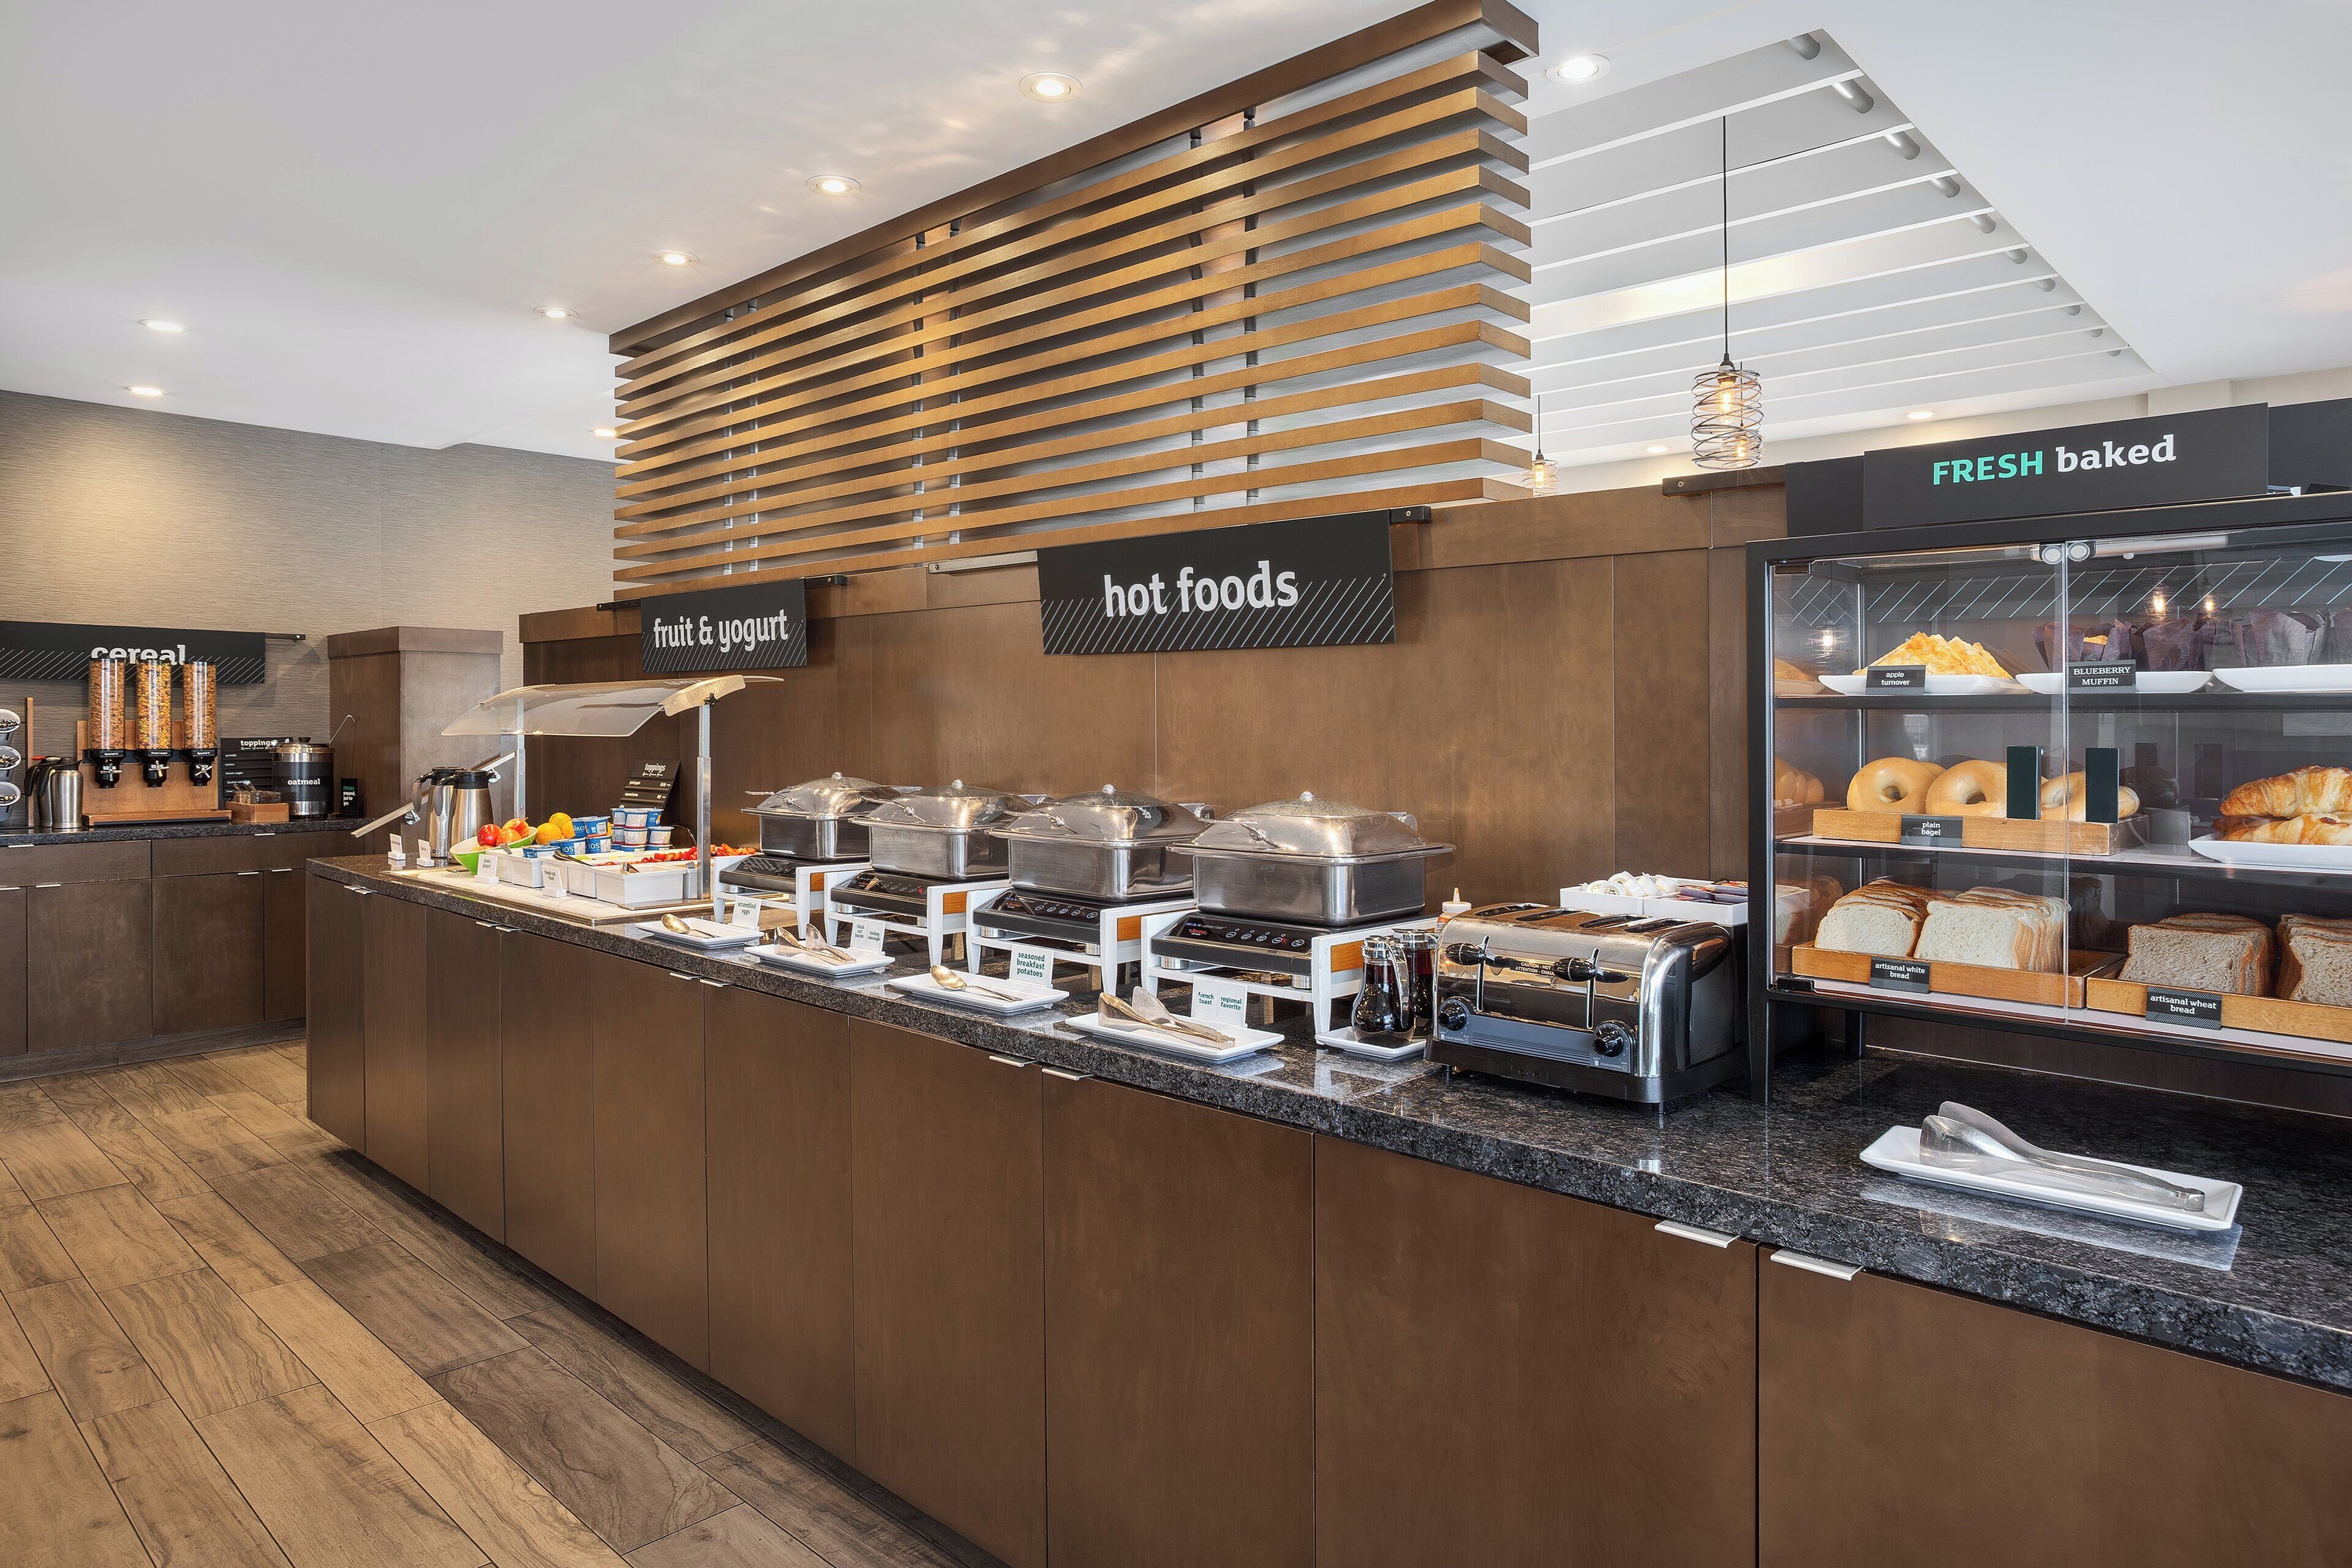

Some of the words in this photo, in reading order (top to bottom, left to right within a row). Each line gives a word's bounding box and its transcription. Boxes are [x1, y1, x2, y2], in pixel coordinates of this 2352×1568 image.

[1933, 450, 2043, 486] FRESH
[2056, 434, 2176, 473] baked
[1104, 573, 1167, 617] hot
[1177, 560, 1298, 612] foods
[654, 616, 693, 648] fruit
[699, 616, 713, 645] &
[718, 609, 788, 653] yogurt
[91, 644, 186, 665] cereal
[2073, 666, 2131, 675] BLUEBERRY
[644, 763, 666, 773] toppings
[1018, 952, 1045, 962] seasoned
[1017, 959, 1044, 970] breakfast
[1875, 963, 1905, 972] artisanal
[1017, 968, 1042, 978] potatoes
[1890, 971, 1910, 979] bread
[1221, 1001, 1241, 1011] favorite
[2150, 995, 2188, 1006] artisanal
[2190, 1000, 2217, 1009] wheat
[2170, 1005, 2195, 1014] bread
